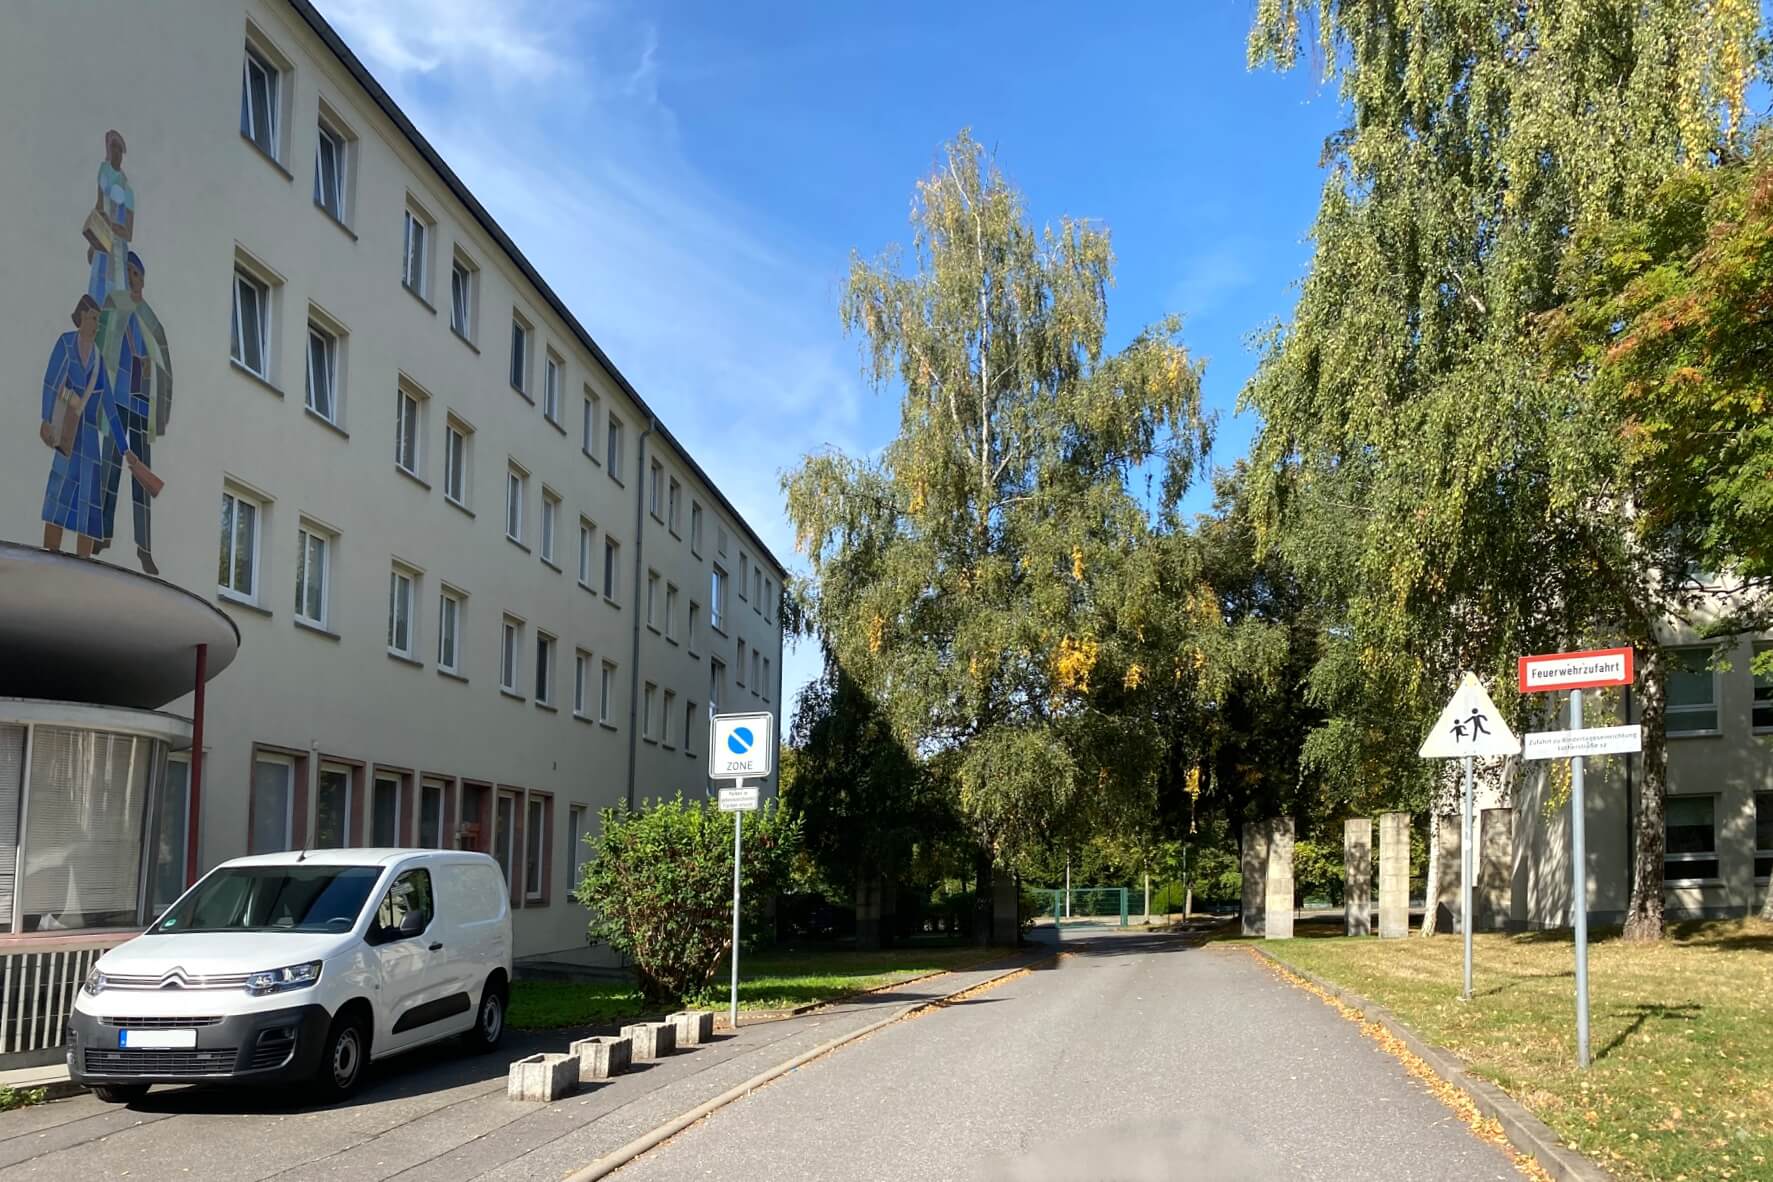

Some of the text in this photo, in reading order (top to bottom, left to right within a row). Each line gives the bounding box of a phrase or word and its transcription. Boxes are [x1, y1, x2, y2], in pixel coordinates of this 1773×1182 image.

[1532, 662, 1619, 679] Feuerwehrzufahrt
[1528, 738, 1552, 746] Zufahrt
[726, 761, 753, 771] ZONE
